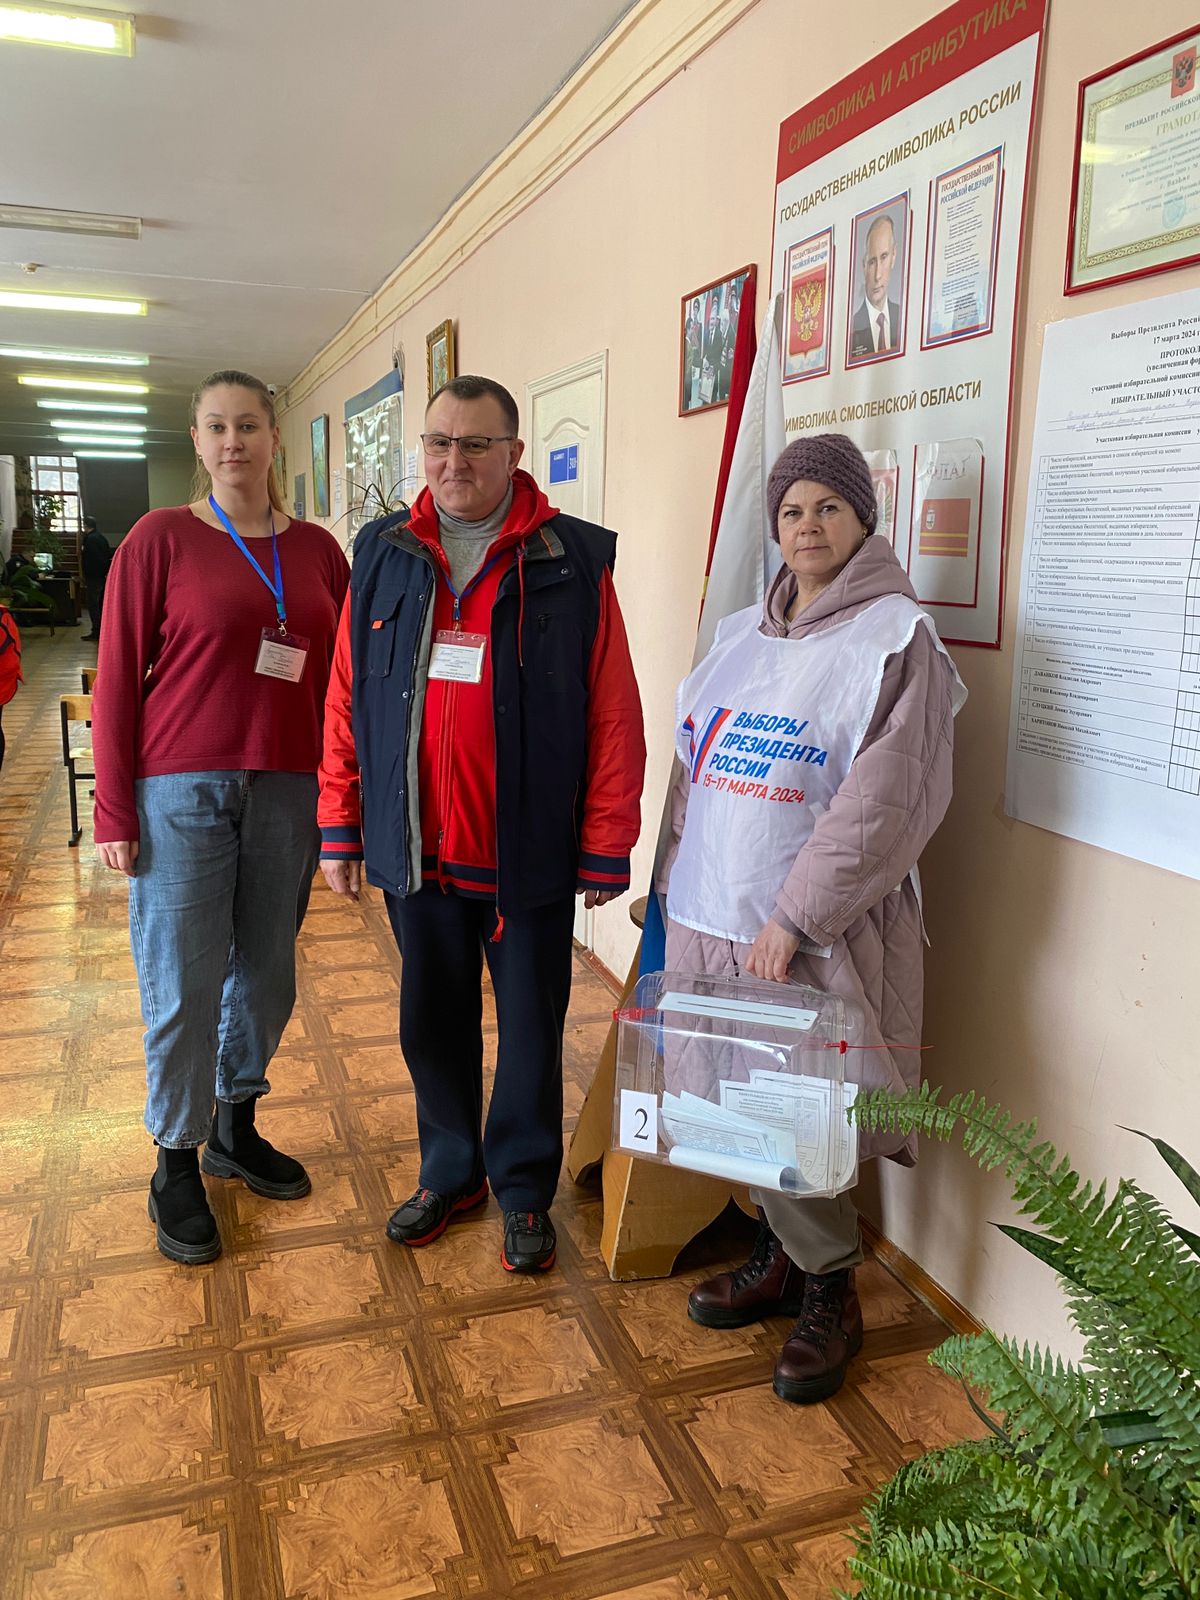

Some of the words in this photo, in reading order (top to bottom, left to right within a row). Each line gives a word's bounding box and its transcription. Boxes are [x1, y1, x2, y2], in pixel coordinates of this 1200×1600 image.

[787, 82, 876, 154] СИМВОЛИКА
[880, 69, 892, 98] И
[896, 0, 1028, 89] АТРИБУТИКА
[1124, 112, 1159, 131] ПРЕЗИДЕНТ
[780, 159, 876, 224] ГОСУДАРСТВЕННАЯ
[877, 117, 956, 173] СИМВОЛИКА
[959, 80, 1022, 131] РОССИИ
[1111, 330, 1136, 340] Выборы
[1138, 321, 1176, 335] Президента
[1161, 334, 1180, 343] марта
[1181, 330, 1196, 339] 2024
[1091, 382, 1122, 394] участковой
[1123, 375, 1168, 388] избирательной
[1111, 389, 1171, 405] ИЗБИРАТЕЛЬНЫЙ
[784, 410, 838, 433] ИМВОЛИКА
[840, 390, 917, 423] СМОЛЕНСКОЙ
[920, 380, 982, 408] ОБЛАСТИ
[1096, 436, 1124, 444] Участковая
[1125, 431, 1163, 441] избирательная
[1164, 429, 1191, 437] комиссия
[732, 711, 810, 737] ВЫБОРЫ
[719, 732, 828, 767] ПРЕЗИДЕНТА
[708, 753, 772, 779] РОССИИ
[726, 780, 769, 800] МАРТА
[769, 787, 806, 804] 2024
[633, 1107, 649, 1141] 2
